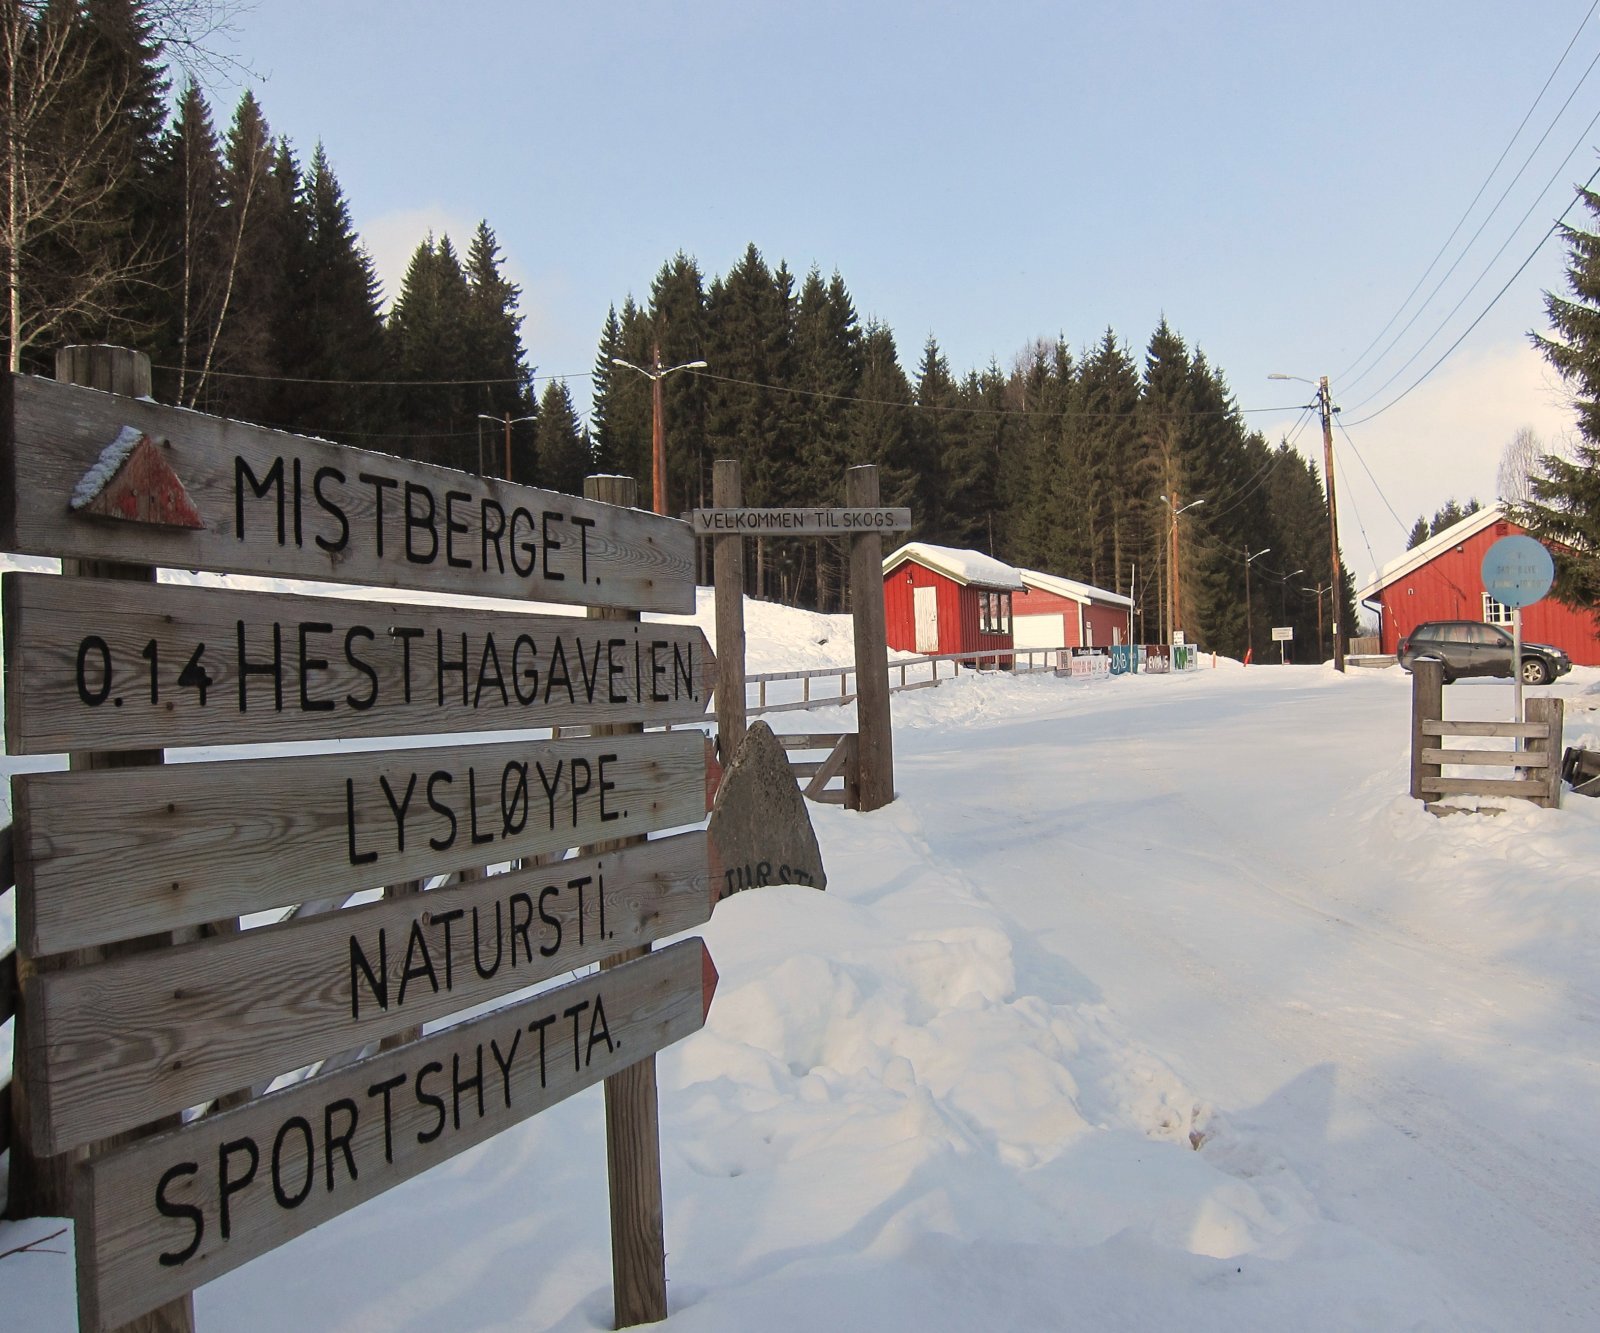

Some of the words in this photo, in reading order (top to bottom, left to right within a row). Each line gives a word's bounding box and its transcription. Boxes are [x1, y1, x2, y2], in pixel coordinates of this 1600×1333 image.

[234, 456, 601, 585] MISTBERGET.
[702, 512, 803, 528] VELKOMMEN
[843, 512, 898, 527] SKOGS.
[346, 753, 628, 865] LYSLØYPE.
[155, 994, 621, 1267] SPORTSHYTTA.
